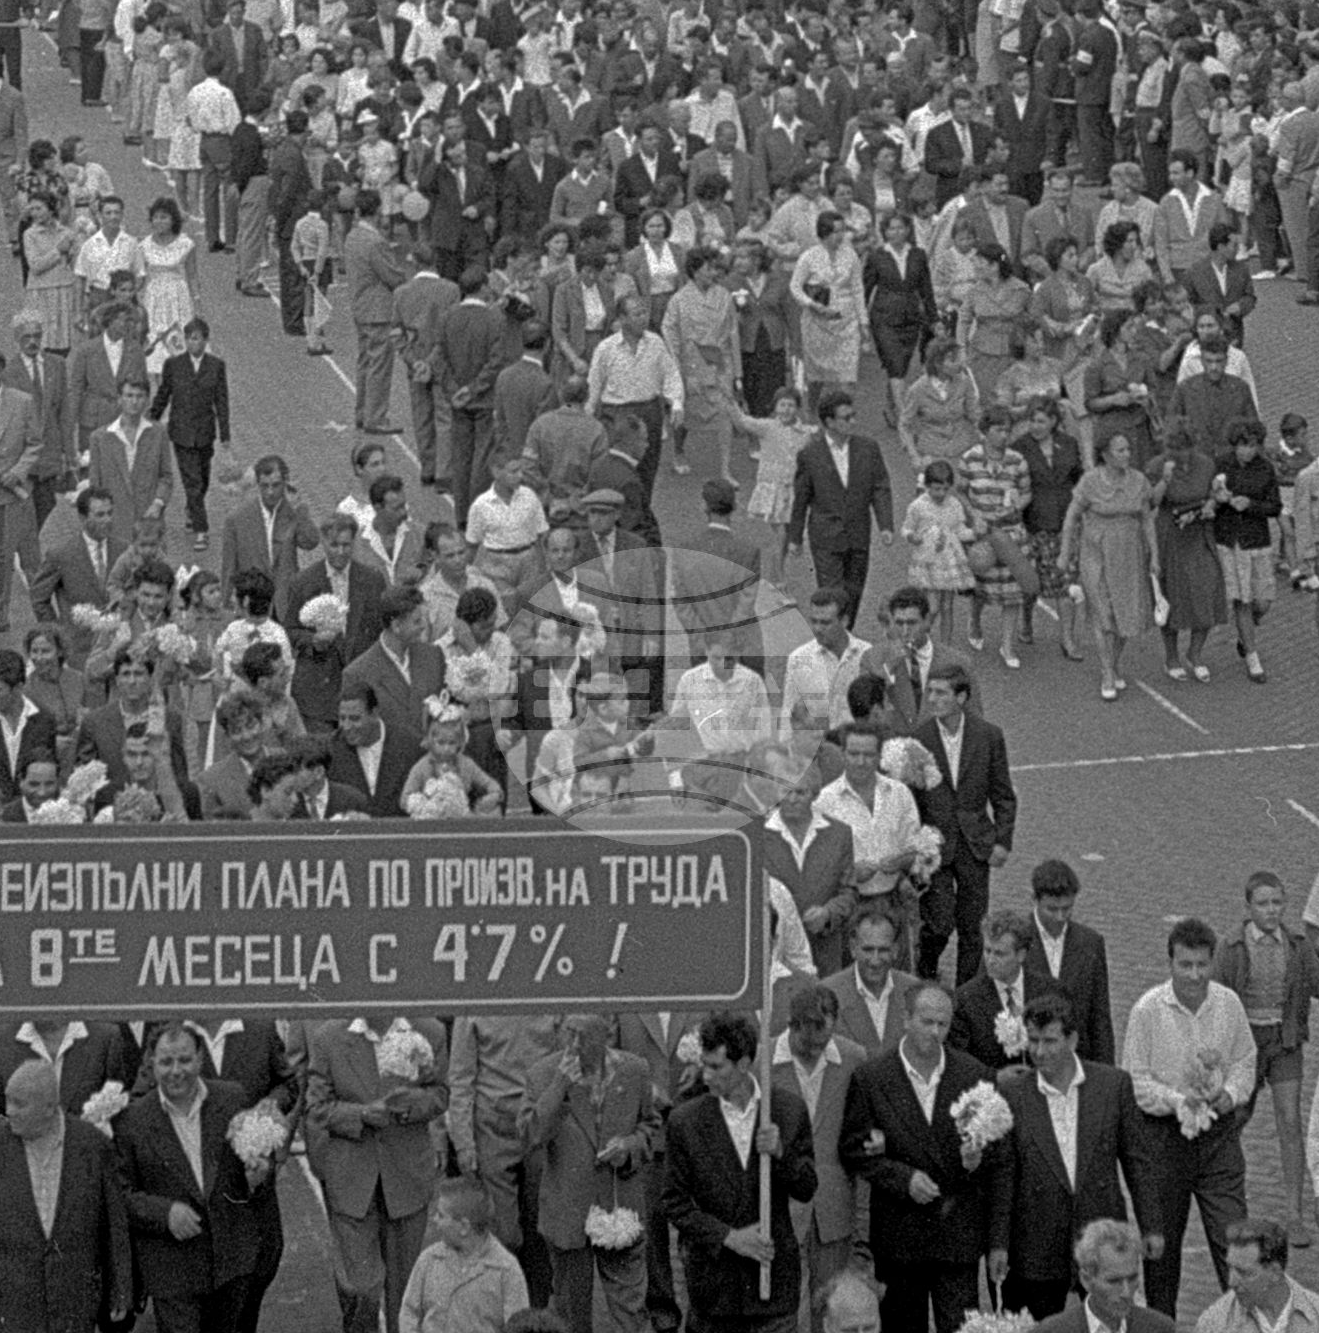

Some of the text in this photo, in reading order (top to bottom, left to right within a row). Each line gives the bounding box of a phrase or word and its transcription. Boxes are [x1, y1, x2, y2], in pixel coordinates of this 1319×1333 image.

[221, 859, 351, 910] ПЛАНА
[368, 858, 411, 909] ПО
[600, 854, 729, 909] ТРУДА
[138, 934, 341, 990] МЕСЕЦА
[368, 933, 398, 984] С
